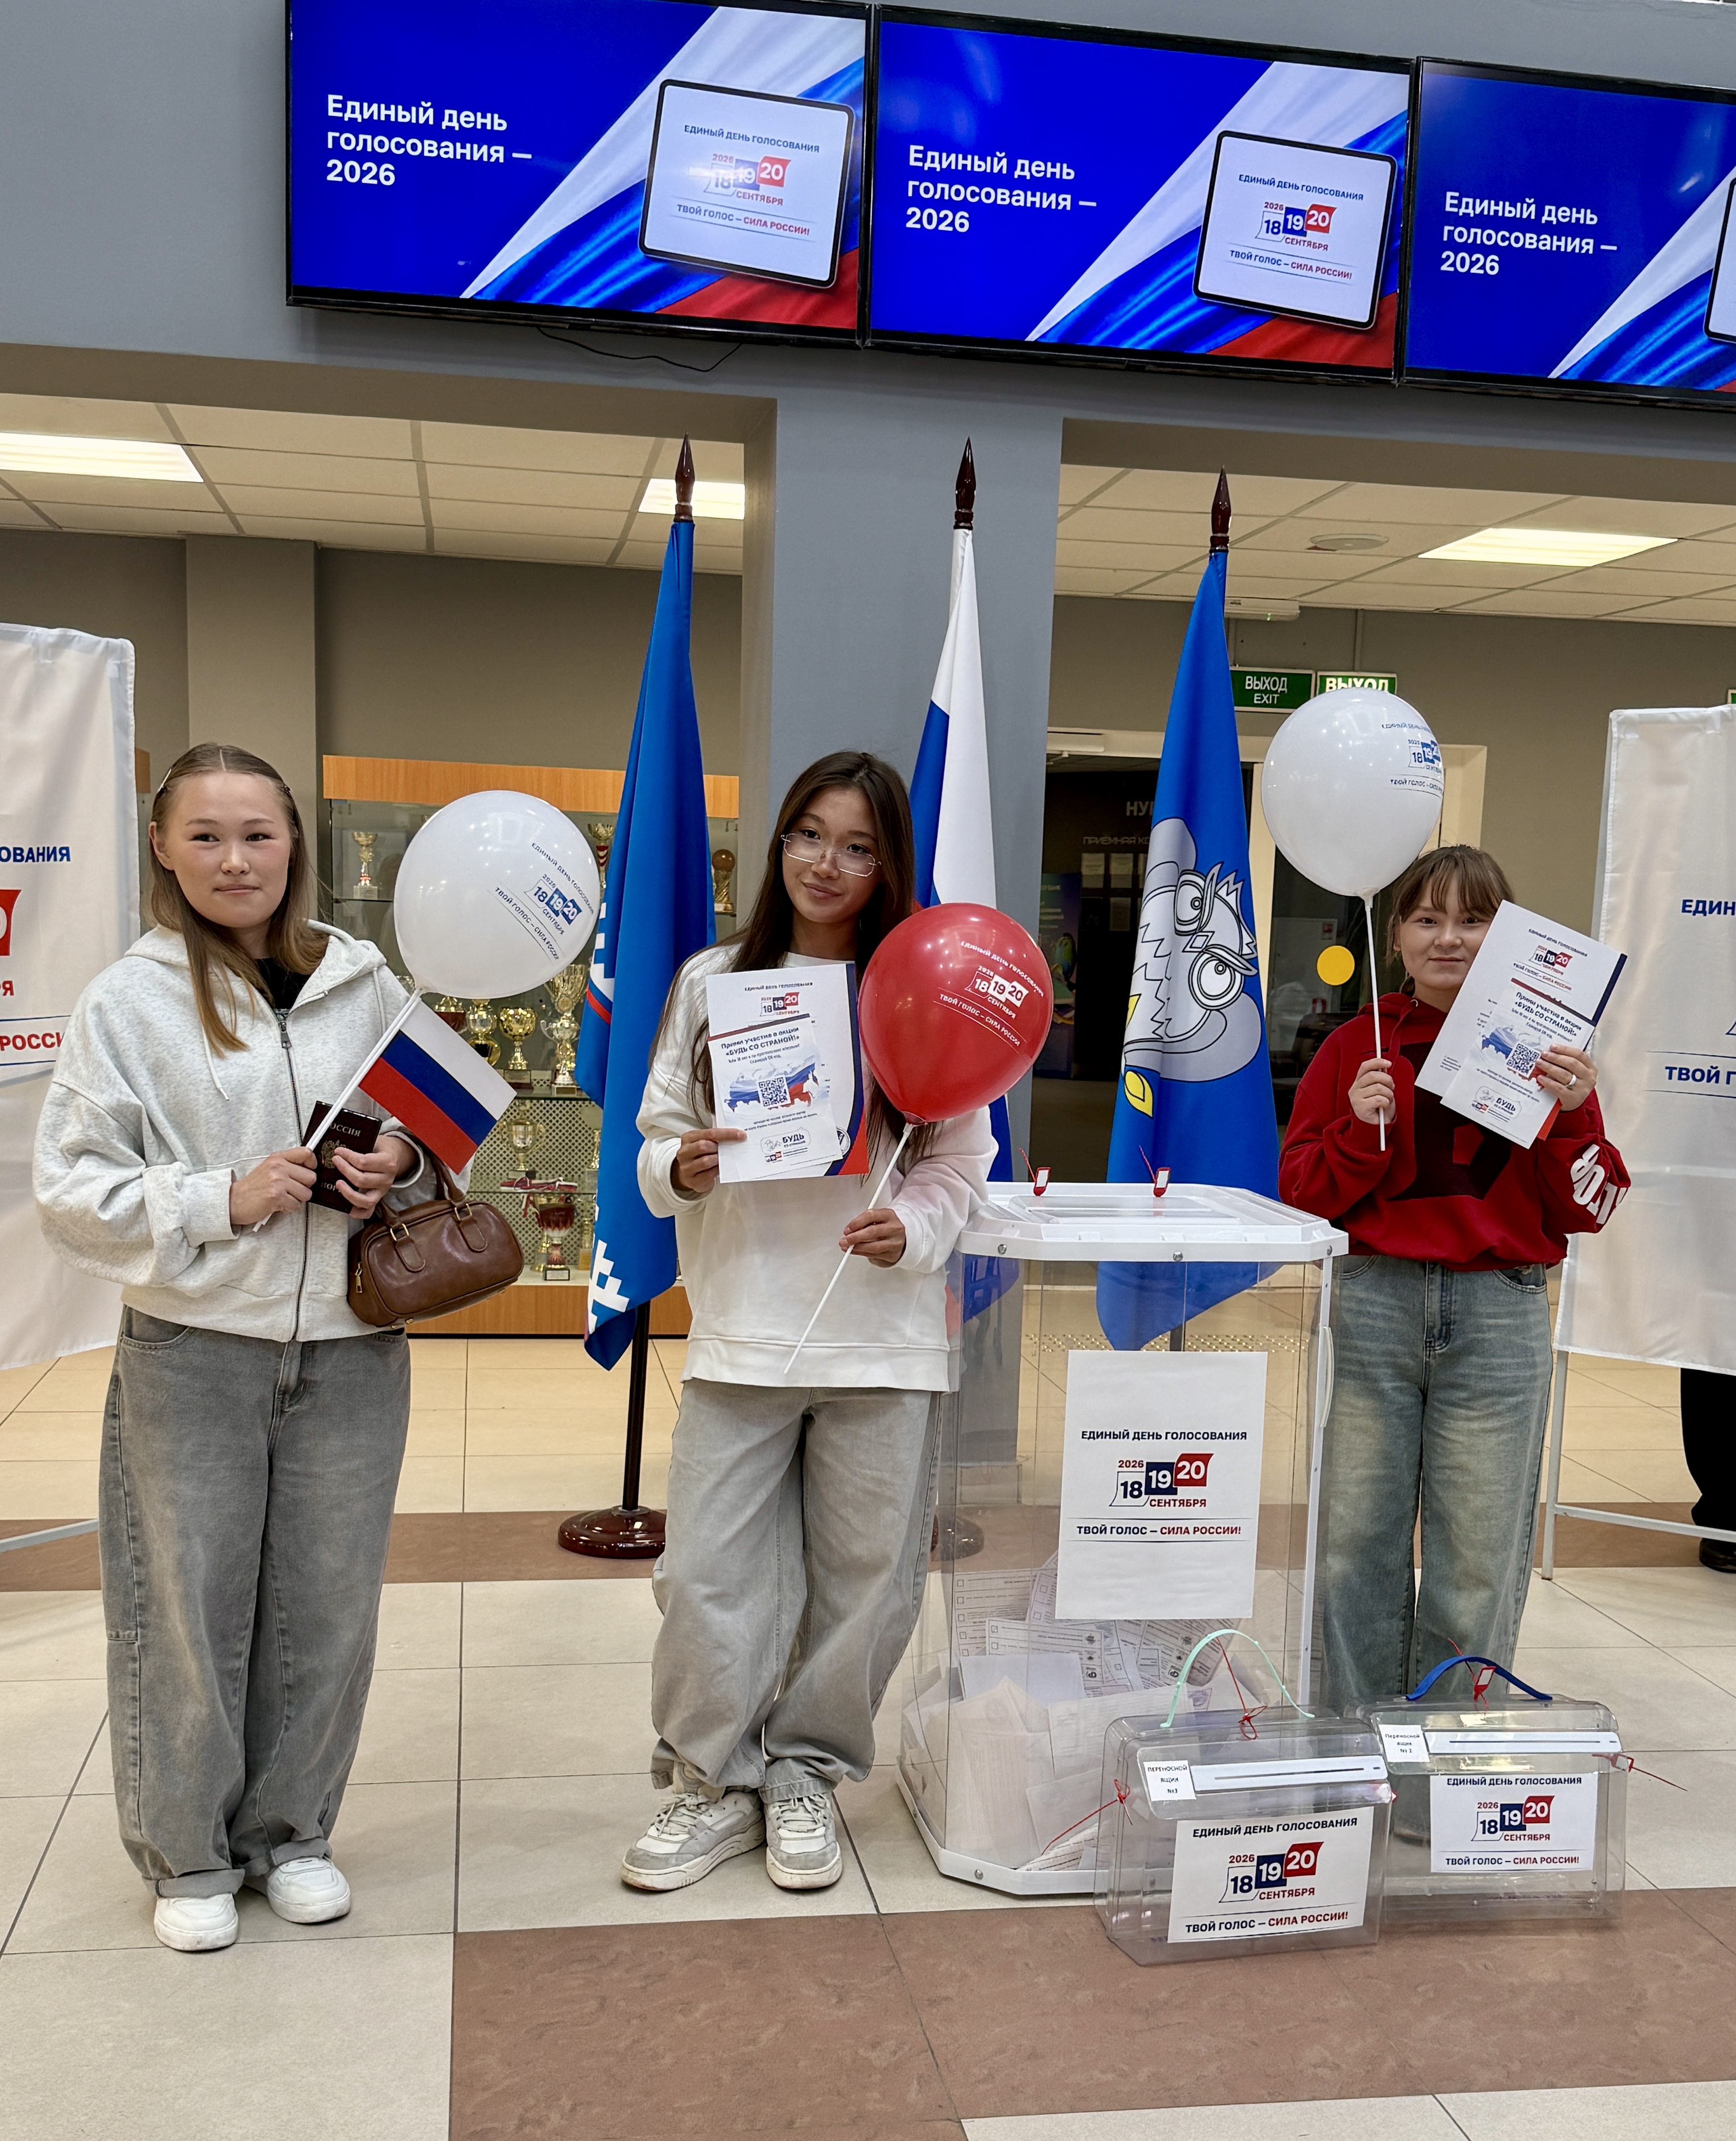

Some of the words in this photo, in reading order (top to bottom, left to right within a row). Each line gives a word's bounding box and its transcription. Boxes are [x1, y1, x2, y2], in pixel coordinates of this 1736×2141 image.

[326, 93, 435, 126] Единый
[442, 107, 507, 132] день
[326, 132, 504, 163] голосования
[684, 125, 724, 138] ЕДИНЫЙ
[725, 132, 750, 142] ДЕНЬ
[752, 136, 819, 153] ГОЛОСОВАНИЯ
[713, 154, 734, 163] 2026
[909, 144, 1007, 175] Единый
[1014, 157, 1075, 180] день
[326, 159, 395, 186] 2026
[760, 163, 783, 180] 20
[907, 179, 1071, 211] голосования
[1239, 174, 1275, 186] ЕДИНЫЙ
[1277, 181, 1299, 190] ДЕНЬ
[1301, 185, 1363, 201] ГОЛОСОВАНИЯ
[737, 191, 783, 206] СЕНТЯБРЯ
[1264, 202, 1284, 211] 2026
[1445, 192, 1536, 219] Единый
[1541, 205, 1597, 225] день
[677, 204, 701, 216] ТВОЙ
[703, 209, 734, 221] ГОЛОС
[743, 217, 768, 228] СИЛА
[770, 222, 810, 235] РОССИИ!
[905, 207, 969, 233] 2026
[1264, 220, 1281, 235] 18
[1286, 214, 1304, 230] 19
[1307, 210, 1329, 227] 20
[1285, 237, 1328, 251] СЕНТЯБРЯ
[1443, 225, 1593, 254] голосования
[1230, 250, 1252, 260] ТВОЙ
[1254, 255, 1282, 265] ГОЛОС
[1291, 262, 1313, 272] СИЛА
[1316, 266, 1352, 279] РОССИИ!
[1441, 251, 1500, 275] 2026
[1245, 676, 1287, 693] ВЫХОД
[1254, 693, 1280, 704] EXIT
[1412, 752, 1422, 763] 18
[532, 843, 557, 866] ЕДИНЫЙ
[557, 865, 571, 881] ДЕНЬ
[534, 886, 547, 903] 18
[550, 894, 564, 911] 19
[563, 902, 578, 920] 20
[495, 887, 513, 904] ТВОЙ
[512, 902, 531, 924] ГОЛОС
[534, 926, 547, 943] СИЛА
[1546, 954, 1555, 962] 19
[1557, 956, 1568, 964] 20
[786, 995, 797, 1003] 20
[940, 994, 958, 1005] ТВОЙ
[974, 979, 988, 992] 18
[993, 981, 1006, 995] 19
[1008, 986, 1023, 1001] 20
[1665, 1065, 1720, 1085] ТВОЙ
[1496, 1097, 1516, 1111] БУДЬ
[330, 1122, 361, 1137] ОССИЯ
[782, 1134, 804, 1143] БУДЬ
[1081, 1429, 1129, 1440] ЕДИНЫЙ
[1132, 1431, 1162, 1441] ДЕНЬ
[1165, 1431, 1247, 1440] ГОЛОСОВАНИЯ
[1118, 1460, 1144, 1468] 2026
[1120, 1481, 1142, 1499] 18
[1149, 1471, 1171, 1488] 19
[1177, 1461, 1205, 1480] 20
[1149, 1499, 1206, 1507] СЕНТЯБРЯ
[1077, 1525, 1106, 1534] ТВОЙ
[1111, 1526, 1147, 1534] ГОЛОС
[1160, 1526, 1190, 1535] СИЛА
[1194, 1526, 1241, 1534] РОССИИ!
[1447, 1777, 1485, 1786] ЕДИНЫЙ
[1489, 1778, 1512, 1786] ДЕНЬ
[1515, 1777, 1581, 1785] ГОЛОСОВАНИЯ
[1193, 1825, 1241, 1838] ЕДИНЫЙ
[1243, 1824, 1274, 1835] ДЕНЬ
[1276, 1818, 1357, 1832] ГОЛОСОВАНИЯ
[1480, 1820, 1498, 1835] 18
[1502, 1810, 1521, 1825] 19
[1525, 1803, 1548, 1818] 20
[1229, 1854, 1255, 1864] 2026
[1446, 1856, 1470, 1865] ТВОЙ
[1231, 1876, 1253, 1894] 18
[1259, 1862, 1282, 1881] 19
[1287, 1850, 1315, 1870] 20
[1259, 1888, 1315, 1900] СЕНТЯБРЯ
[1186, 1921, 1215, 1933] ТВОЙ
[1218, 1920, 1255, 1931] ГОЛОС
[1268, 1916, 1298, 1926] СИЛА
[1301, 1912, 1348, 1924] РОССИИ!
